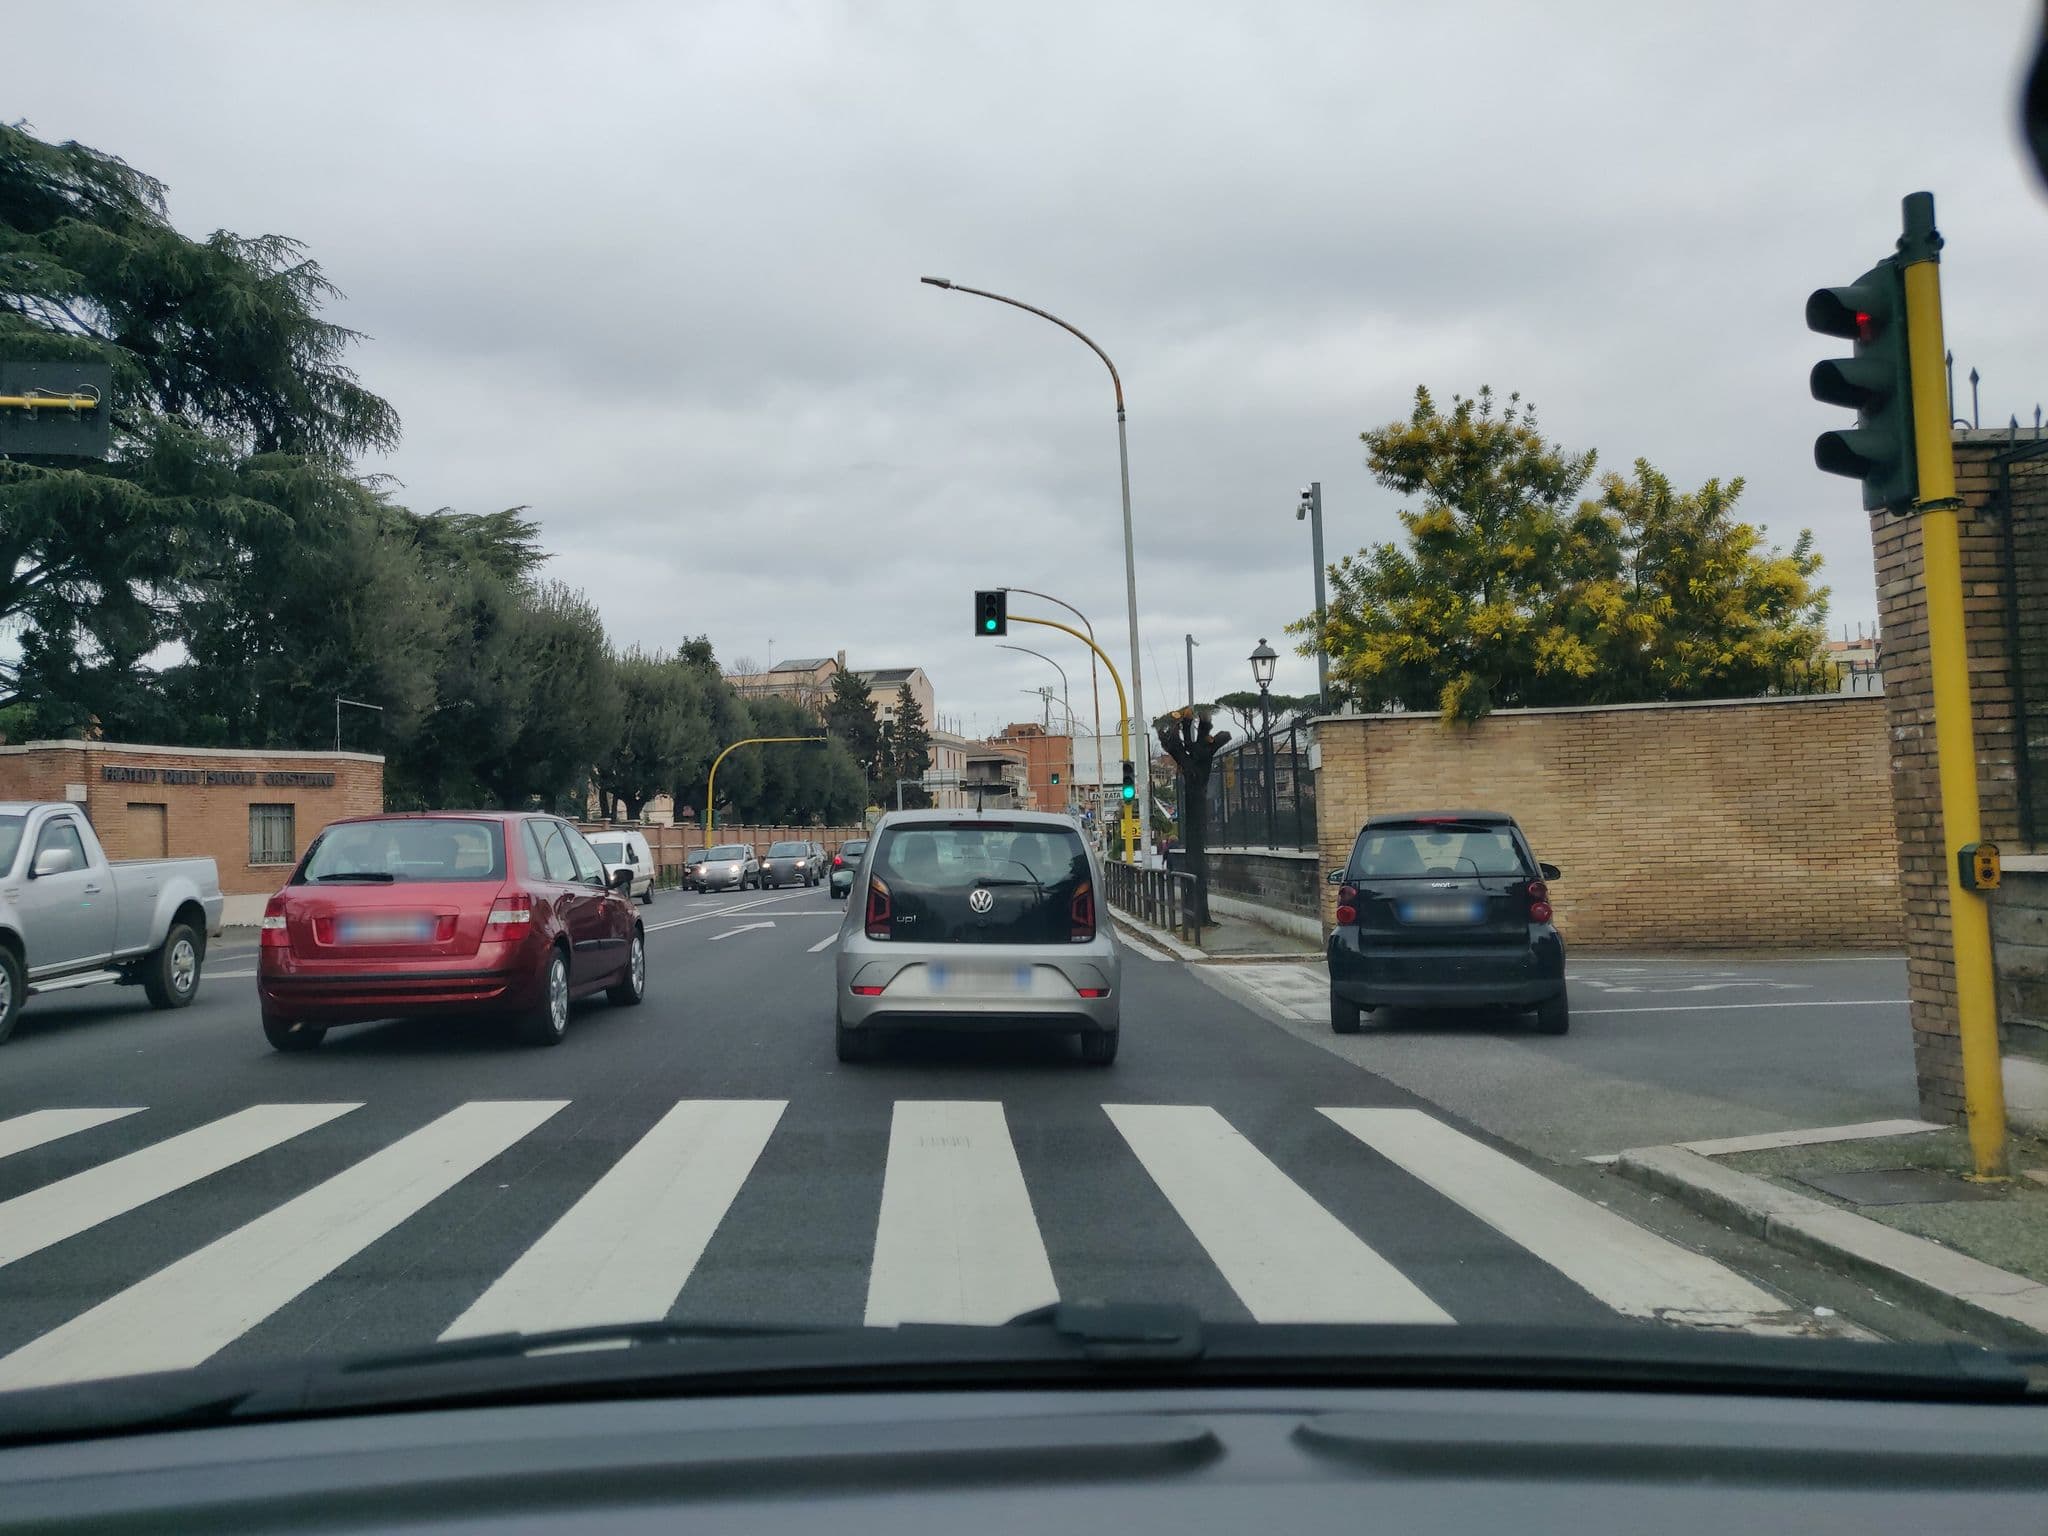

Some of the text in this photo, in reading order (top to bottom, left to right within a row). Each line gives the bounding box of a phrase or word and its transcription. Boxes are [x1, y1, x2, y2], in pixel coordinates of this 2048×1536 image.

[1092, 791, 1121, 800] ENRATA
[970, 889, 993, 913] VW
[896, 914, 917, 925] up!
